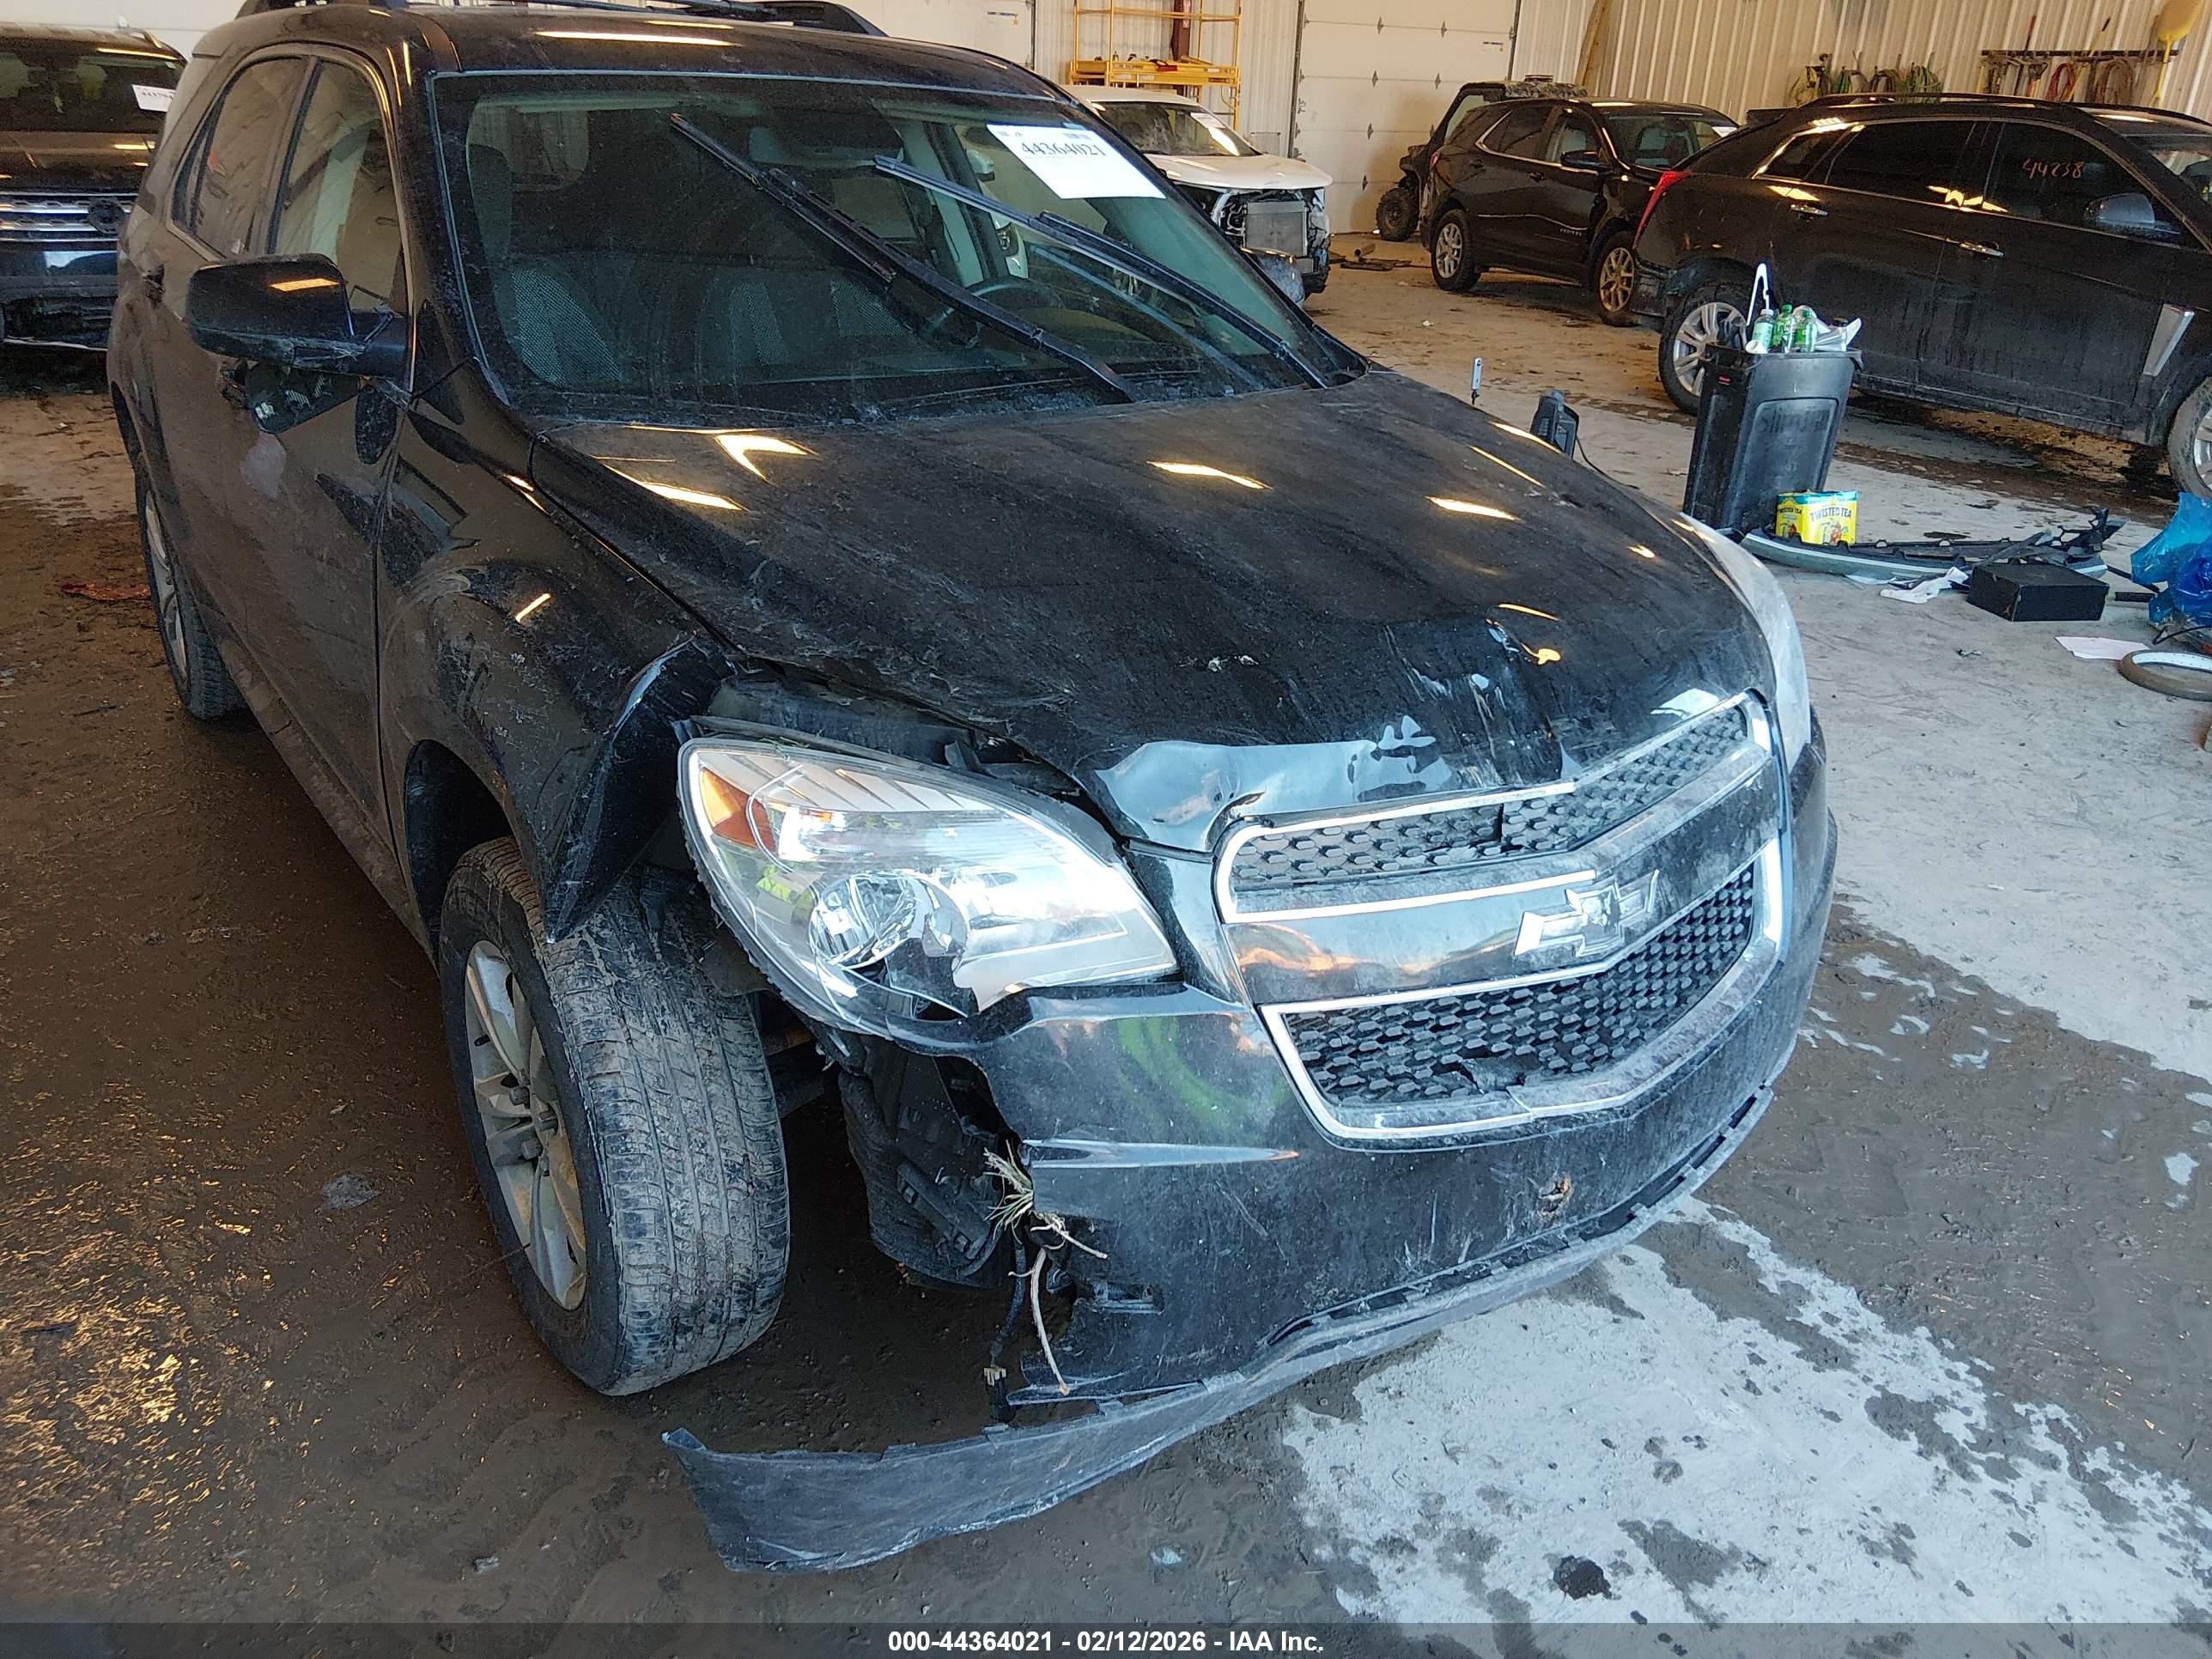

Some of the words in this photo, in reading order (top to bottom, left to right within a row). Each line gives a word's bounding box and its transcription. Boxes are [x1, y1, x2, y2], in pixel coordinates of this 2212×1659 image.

[1021, 142, 1107, 157] 44364021
[1809, 507, 1840, 522] TWISTED
[1841, 507, 1852, 519] TEA
